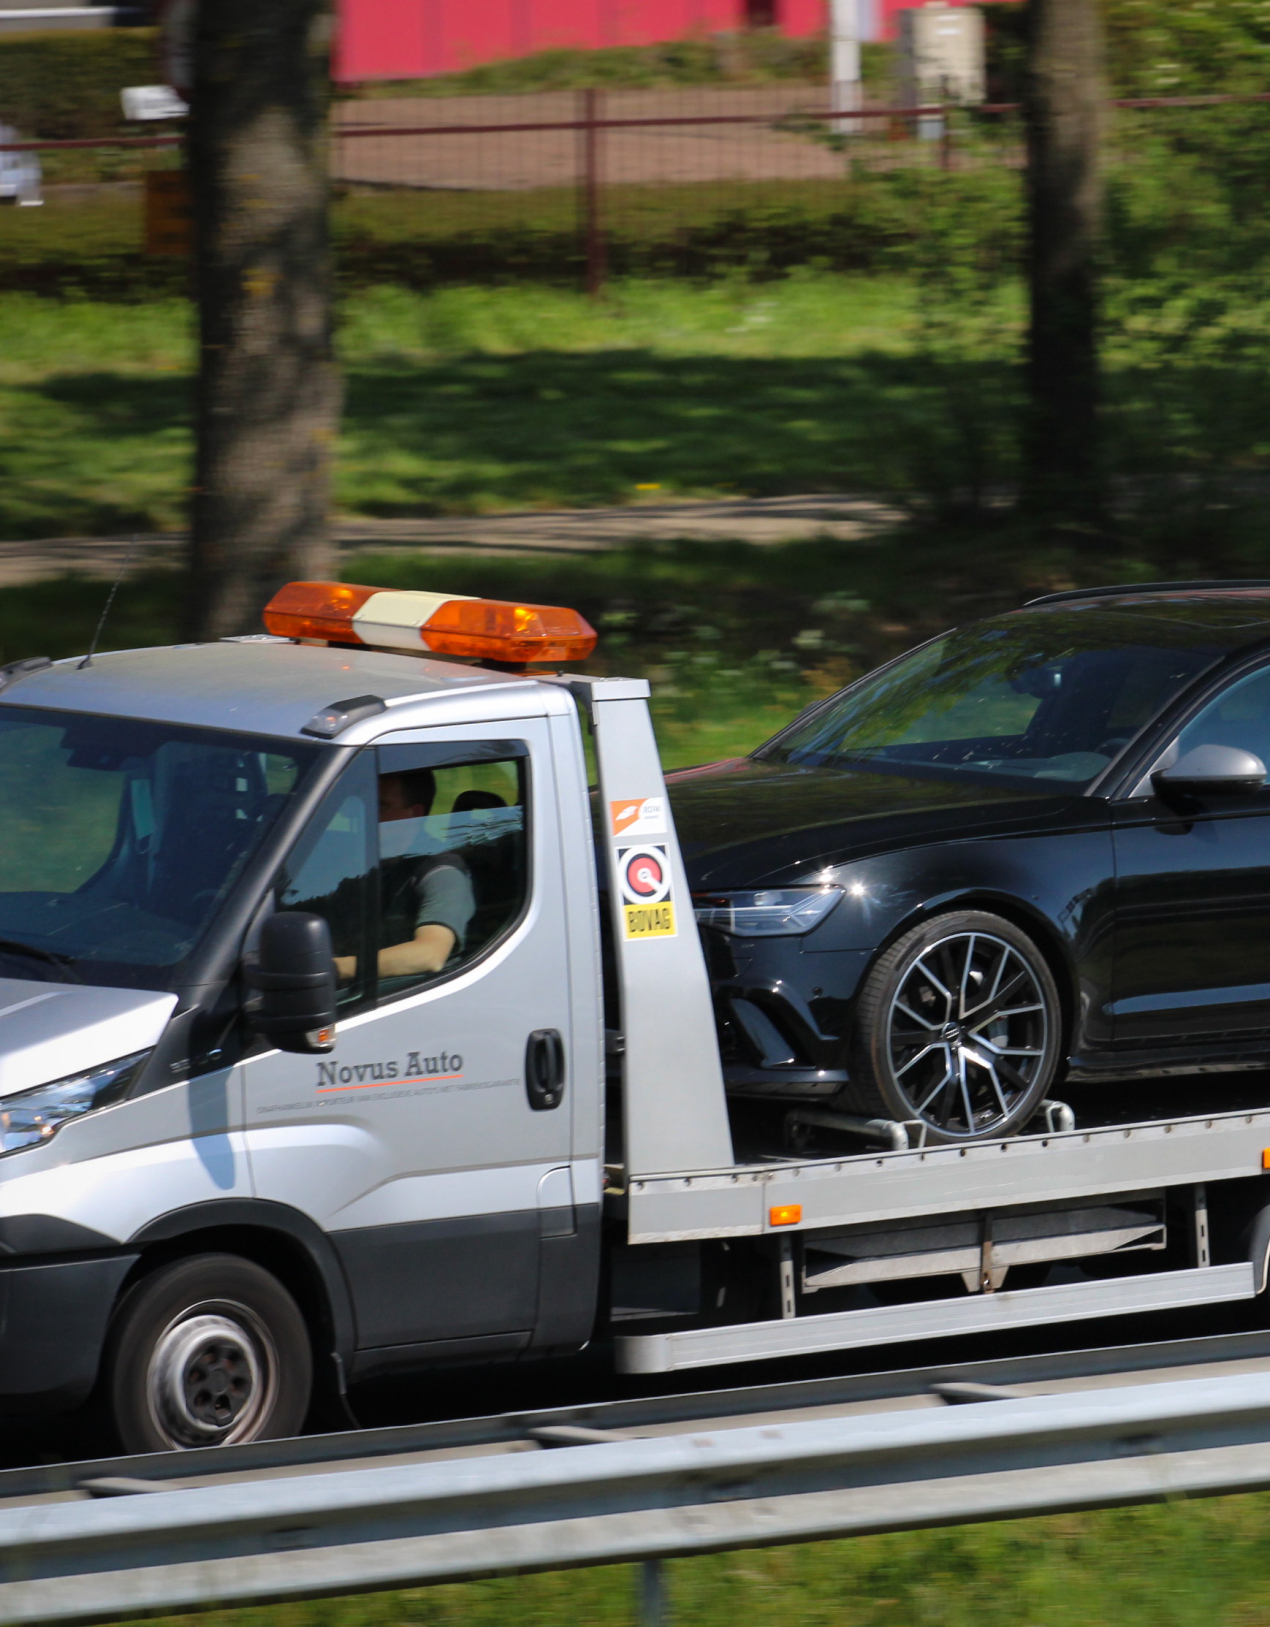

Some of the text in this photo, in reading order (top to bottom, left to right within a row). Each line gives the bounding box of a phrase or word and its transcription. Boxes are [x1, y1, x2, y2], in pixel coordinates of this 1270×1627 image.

[627, 907, 671, 933] BOVAG
[316, 1050, 464, 1087] Novus Auto
